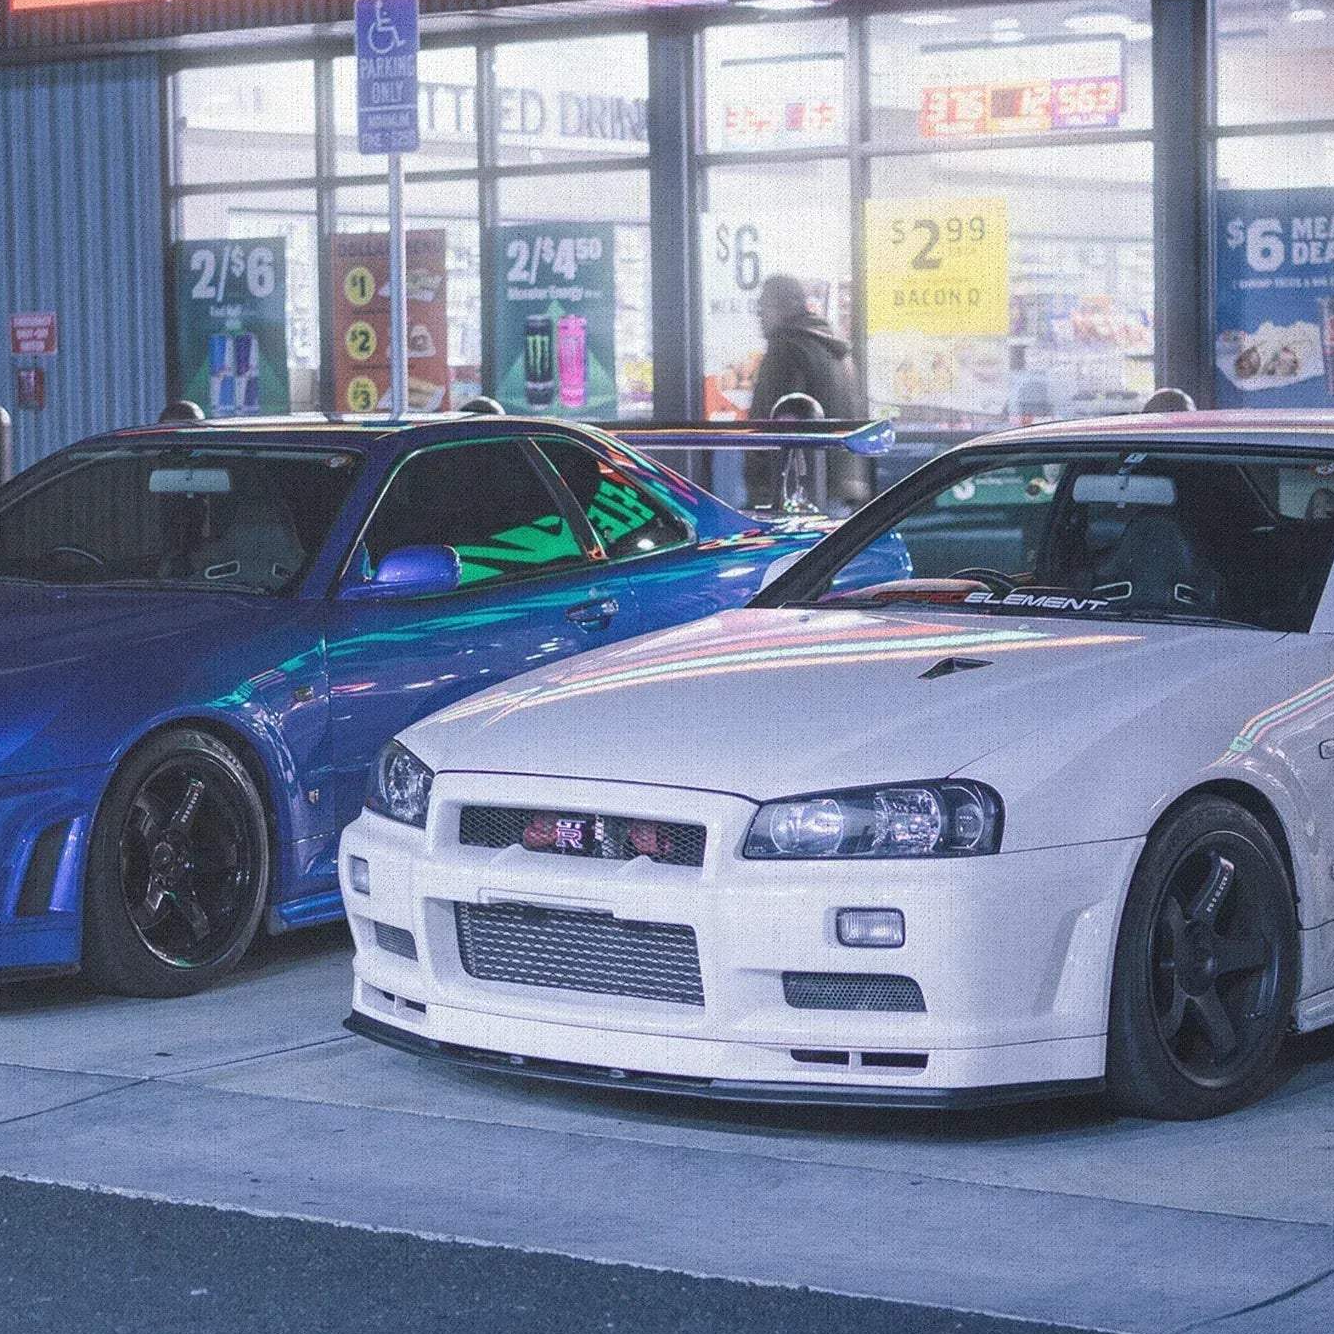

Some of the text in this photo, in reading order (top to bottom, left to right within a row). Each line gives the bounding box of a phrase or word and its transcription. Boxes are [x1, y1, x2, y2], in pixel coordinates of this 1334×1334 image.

[360, 55, 415, 79] PARKING
[371, 81, 404, 103] ONLY
[419, 83, 648, 141] TTED DRIN
[1227, 217, 1285, 273] $6
[716, 223, 761, 292] $6
[190, 245, 276, 303] 2/$6
[351, 273, 367, 298] $1
[893, 288, 961, 306] BACON
[351, 330, 371, 354] $2
[964, 591, 1109, 611] ELEMENT
